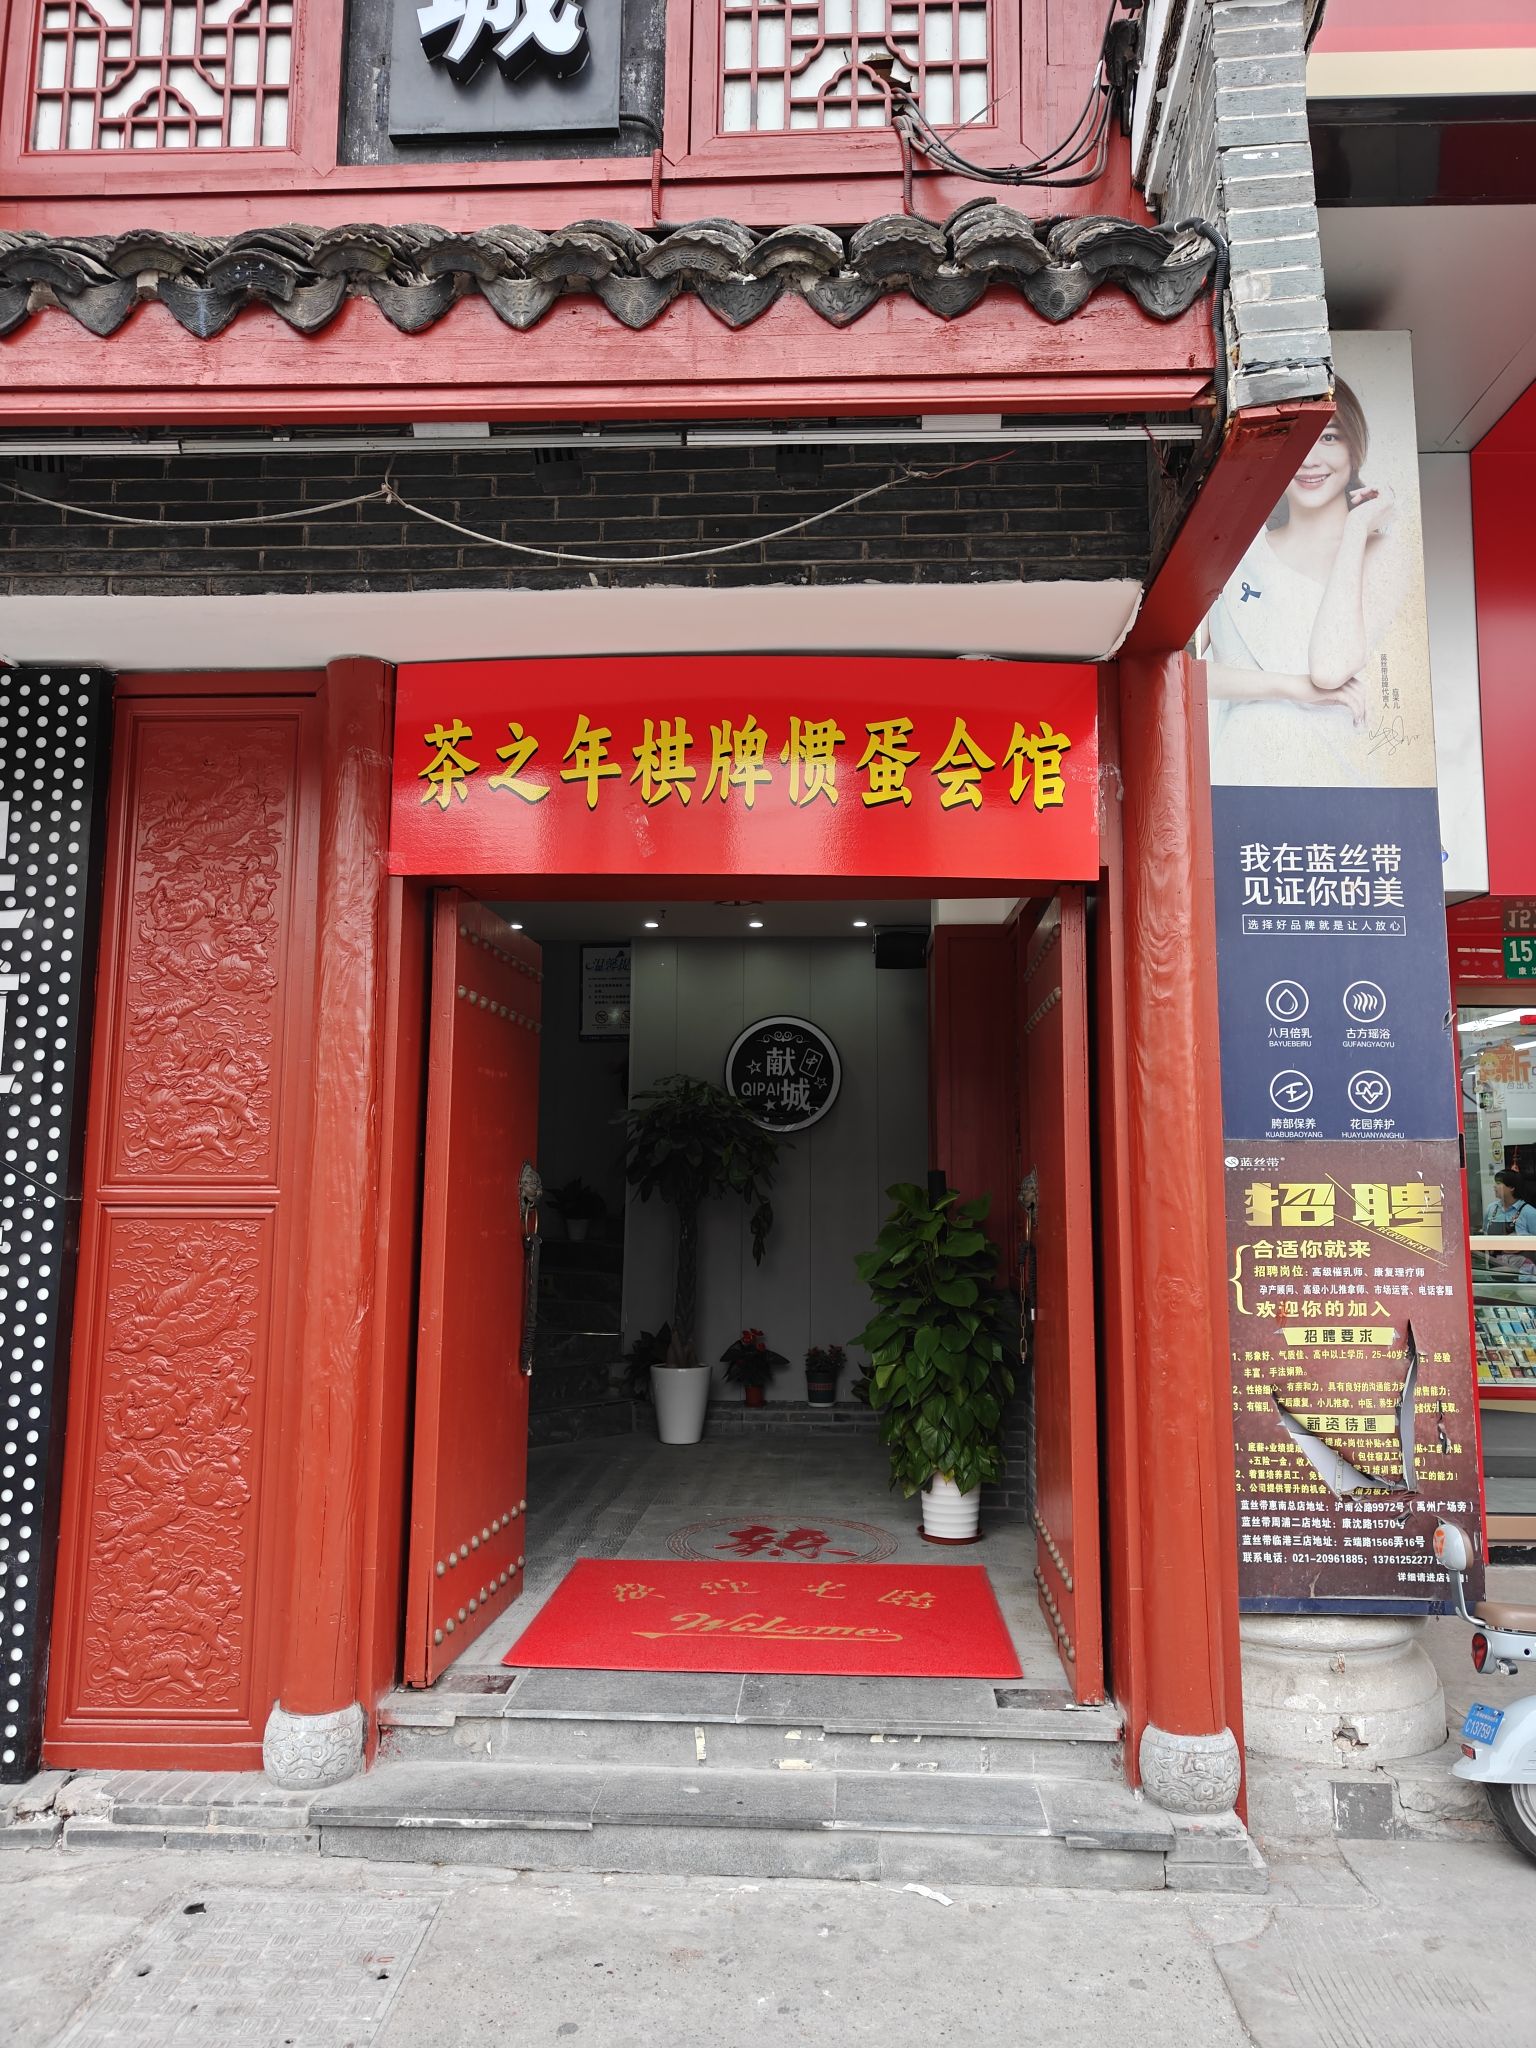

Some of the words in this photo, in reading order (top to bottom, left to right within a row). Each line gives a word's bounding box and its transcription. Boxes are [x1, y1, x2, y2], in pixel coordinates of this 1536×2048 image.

[418, 713, 1072, 810] 茶之年棋牌惯蛋会馆
[1240, 843, 1402, 874] 我在蓝丝带
[1241, 876, 1405, 908] 见证你的美
[1247, 919, 1401, 932] 选择好品牌就是让人放心
[1268, 1027, 1313, 1039] 八月倍乳
[1345, 1028, 1391, 1040] 古方瑶浴
[1269, 1040, 1312, 1048] BAYUEBEIRU
[1342, 1040, 1395, 1048] GUFANGYAOYU
[766, 1047, 796, 1077] 献
[741, 1082, 780, 1097] QIPAI
[781, 1078, 810, 1111] 城
[1271, 1118, 1317, 1130] 胯部保养
[1350, 1118, 1395, 1130] 花园养护
[1265, 1131, 1323, 1139] KUABUBAOYANG
[1341, 1131, 1405, 1139] HUAYUANYANGHU
[1240, 1157, 1280, 1167] 蓝丝带
[1244, 1182, 1443, 1253] 招聘
[1377, 1226, 1431, 1253] RECRUITMENT
[1252, 1239, 1371, 1259] 合适你就来
[1255, 1300, 1391, 1318] 欢迎你的加入
[1304, 1328, 1373, 1343] 招聘要求
[1307, 1416, 1377, 1432] 薪资待遇
[670, 1612, 891, 1640] Welcome
[1464, 1718, 1496, 1741] C137591
